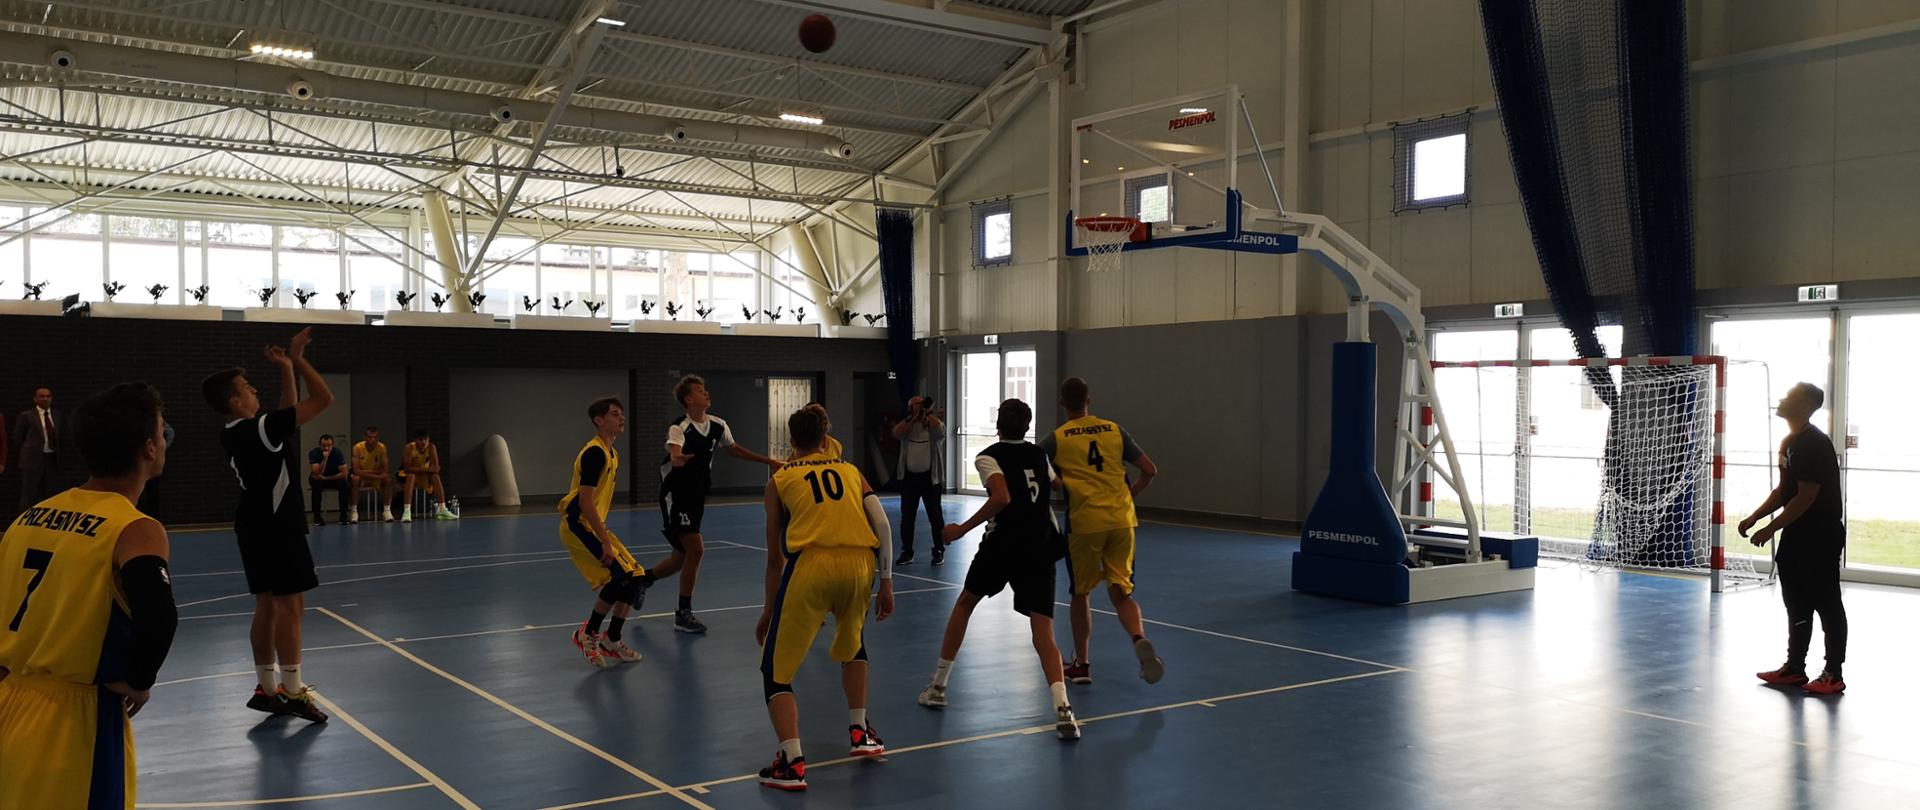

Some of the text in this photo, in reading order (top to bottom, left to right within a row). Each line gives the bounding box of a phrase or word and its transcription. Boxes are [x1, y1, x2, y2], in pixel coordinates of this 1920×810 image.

[1168, 112, 1216, 131] PESMENPOL
[1088, 441, 1104, 472] 4
[803, 469, 844, 505] 10
[1023, 469, 1040, 503] 5
[18, 507, 107, 537] PRZASNYSZ
[679, 512, 691, 526] 23
[1308, 530, 1379, 546] PESMENPOL
[9, 548, 54, 632] 7
